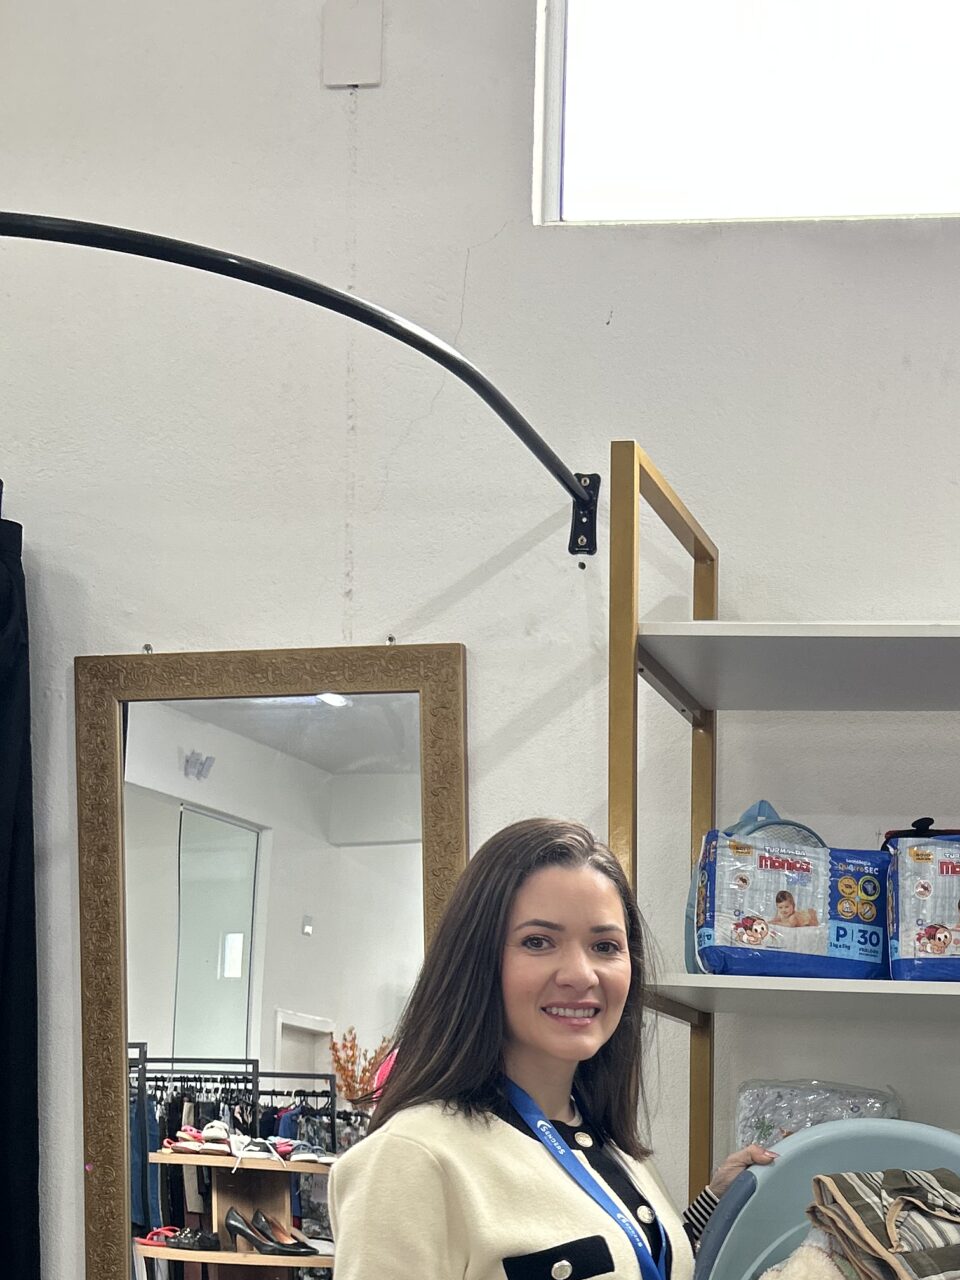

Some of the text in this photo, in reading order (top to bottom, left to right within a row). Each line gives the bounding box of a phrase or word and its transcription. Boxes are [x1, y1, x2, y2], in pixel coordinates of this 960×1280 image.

[758, 855, 812, 874] Mônica
[836, 926, 881, 947] P 30
